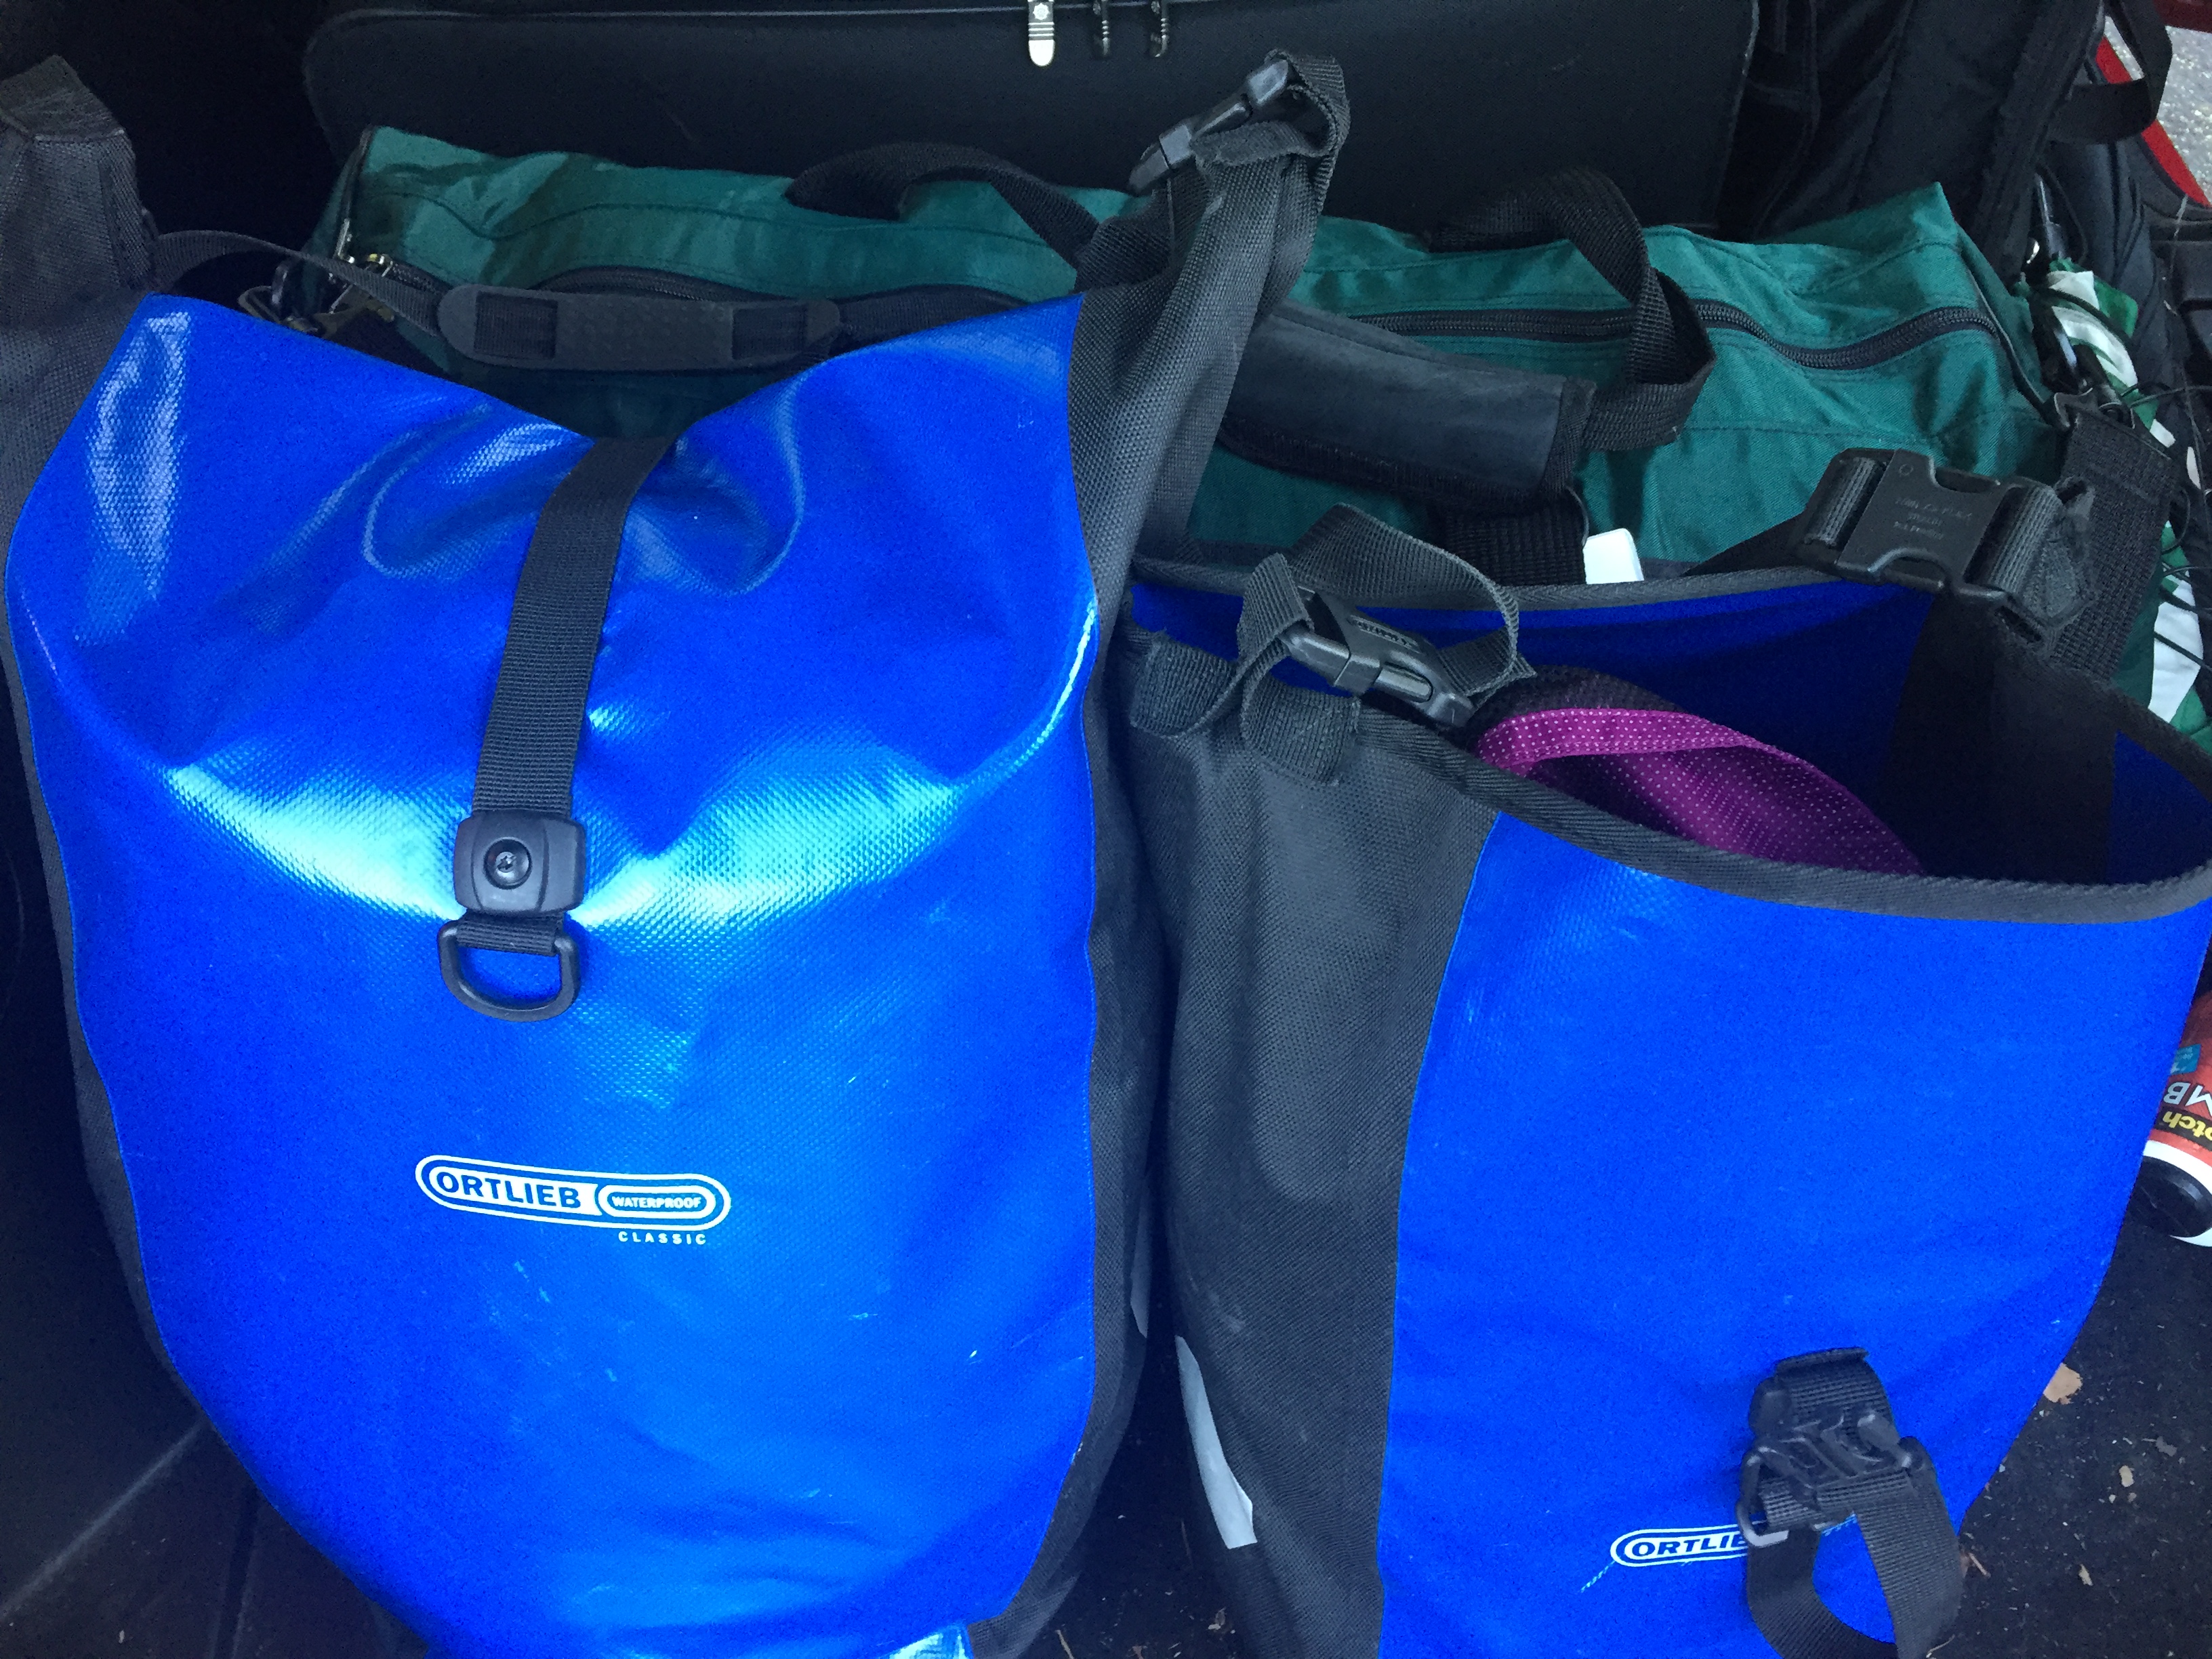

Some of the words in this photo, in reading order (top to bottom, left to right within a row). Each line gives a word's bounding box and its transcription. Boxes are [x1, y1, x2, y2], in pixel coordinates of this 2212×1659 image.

[436, 1172, 581, 1208] ORTLIEB
[613, 1195, 701, 1209] WATERPROOF
[618, 1231, 706, 1244] CLASSIC
[1632, 1536, 1747, 1557] ORTLIE
